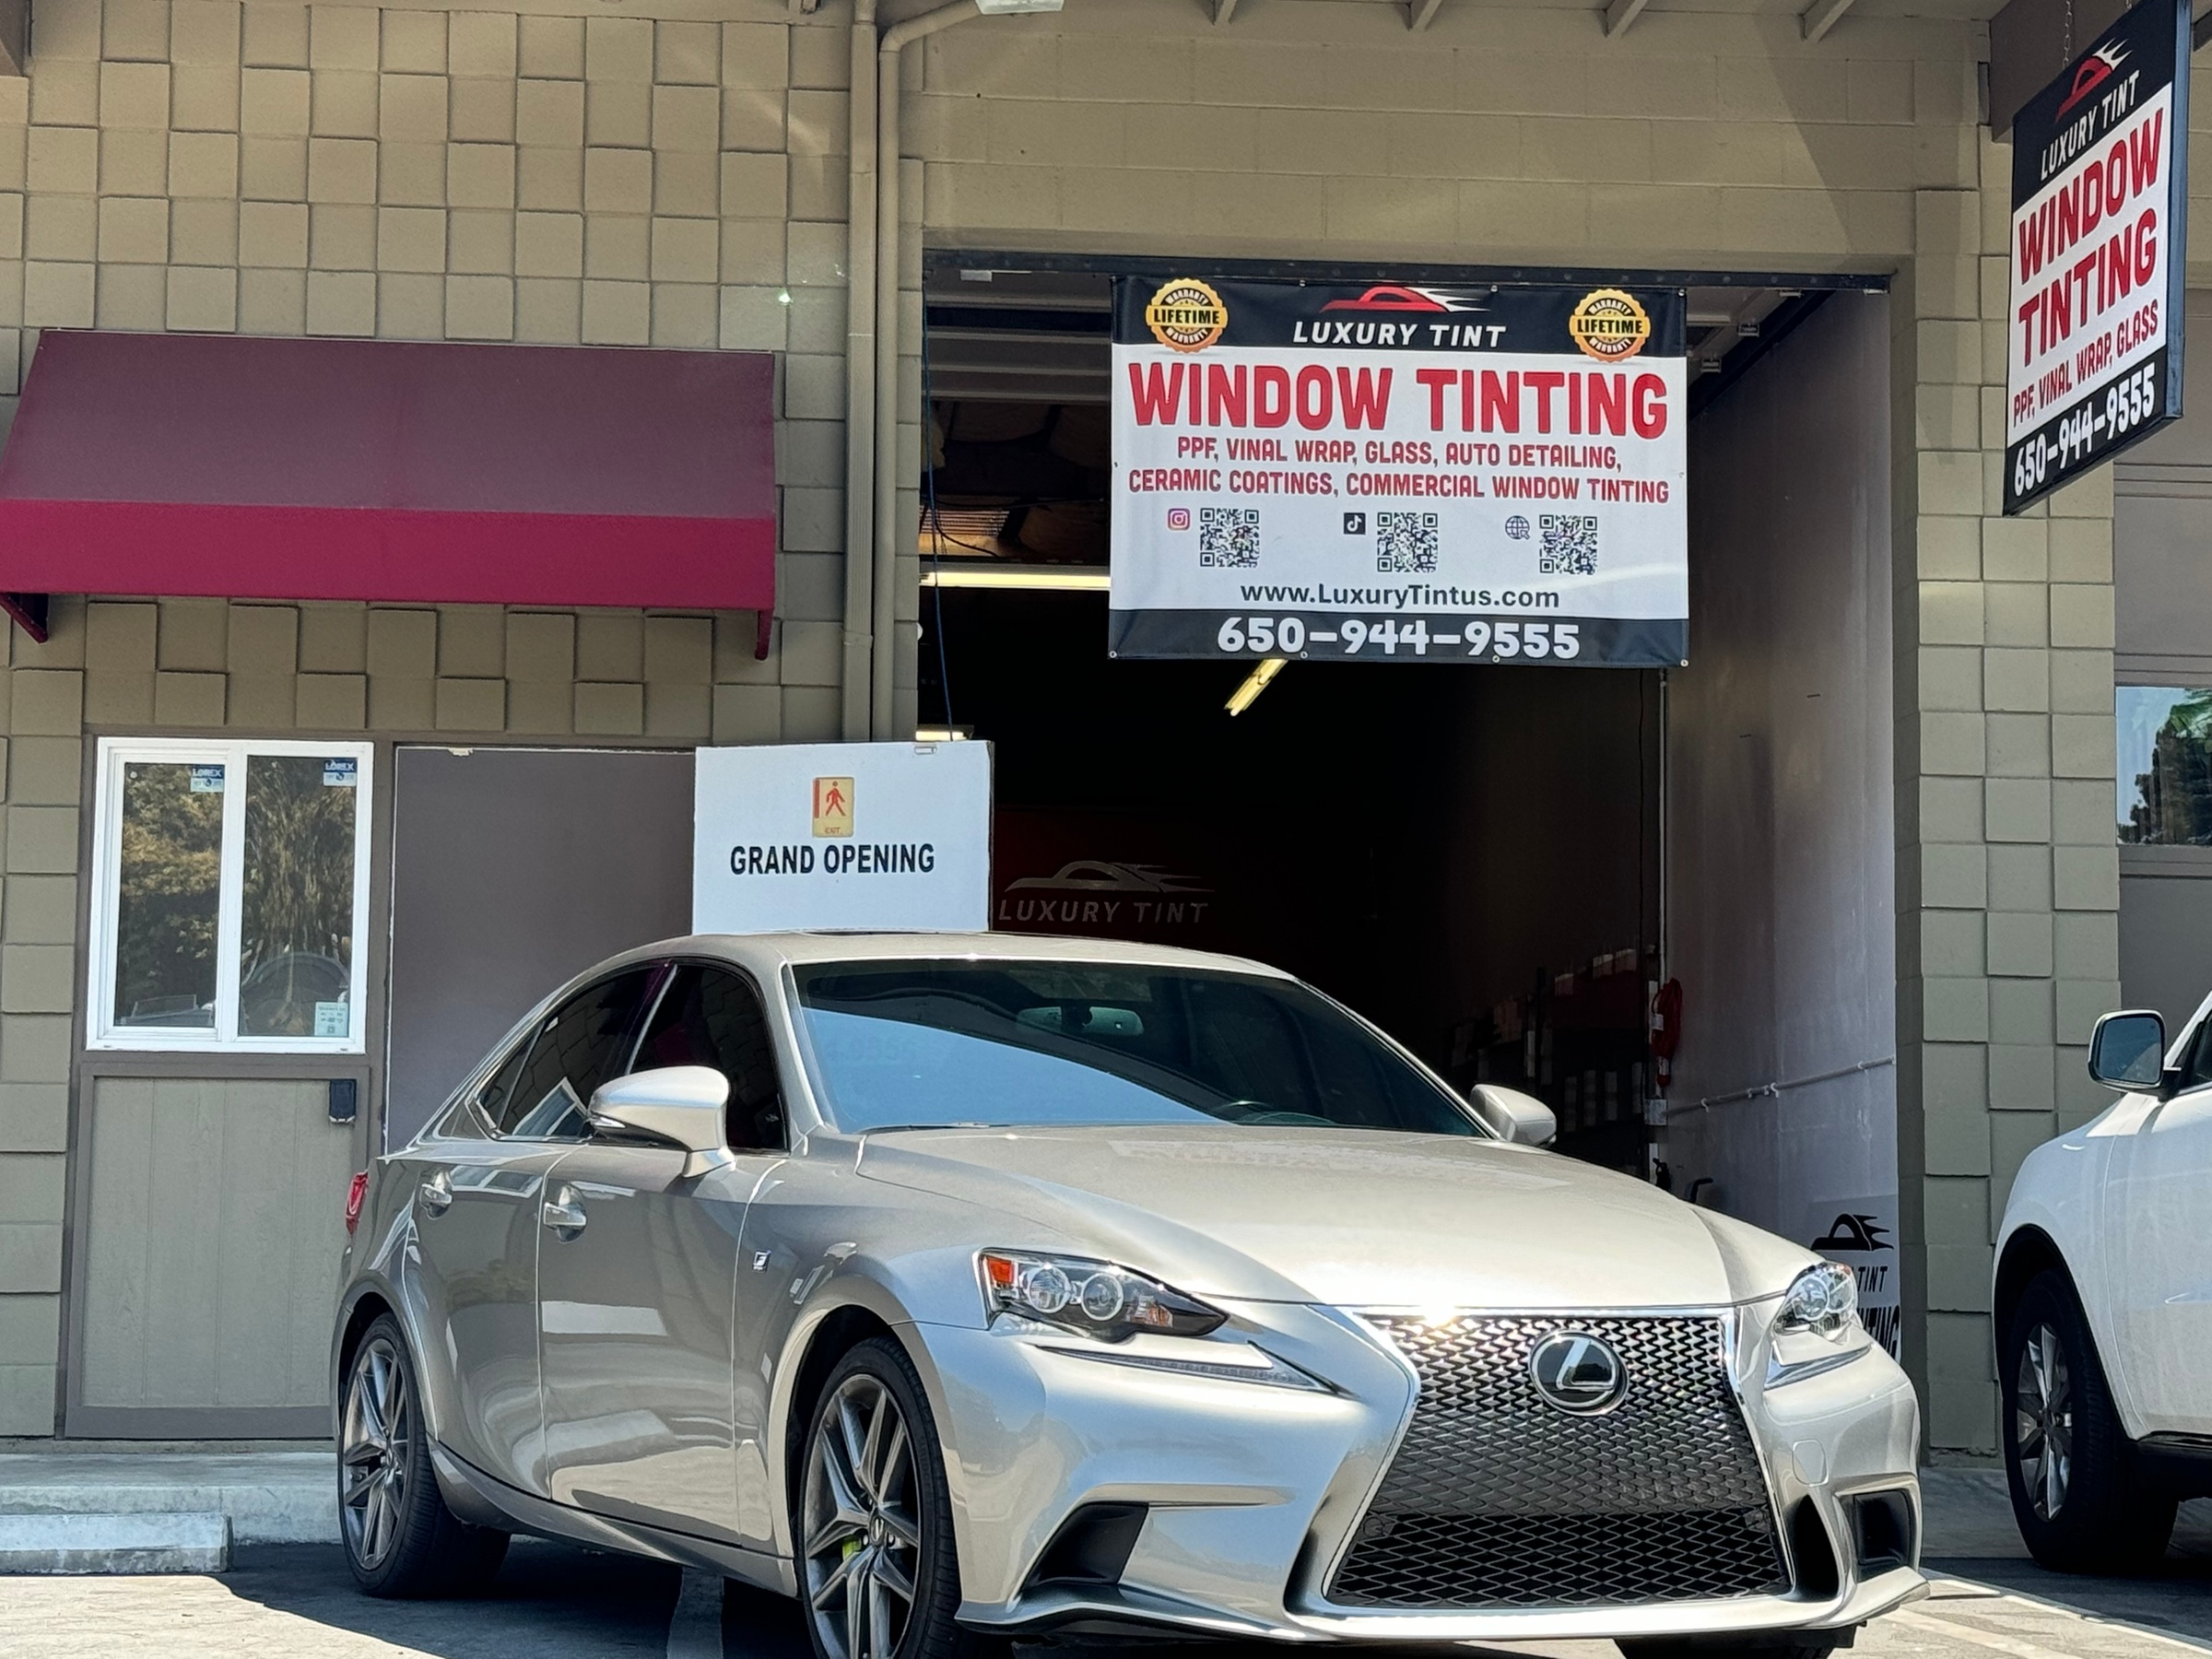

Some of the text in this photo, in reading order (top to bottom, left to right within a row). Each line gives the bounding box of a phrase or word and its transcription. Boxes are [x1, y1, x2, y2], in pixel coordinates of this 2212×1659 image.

[2041, 69, 2140, 182] LUXURY TINT
[2018, 107, 2164, 286] WINDOW
[2018, 207, 2158, 368] TINTING
[1154, 309, 1220, 324] LIFETIME
[1293, 322, 1507, 347] LUXURY TINT
[1577, 319, 1643, 335] LIFETIME
[2013, 298, 2159, 429] PPF, VINAL WRAP, GLASS
[1128, 362, 1668, 440] WINDOW TINTING
[2014, 361, 2156, 497] 650-944-9555
[1178, 436, 1622, 473] PPF, VINAL WRAP, GLASS, AUTO DETAILING,
[1129, 468, 1670, 504] CERAMIC COATINGS, COMMERCIAL WINDOW TINTING
[1241, 582, 1560, 609] www.LuxuryTintus.com
[1218, 617, 1581, 660] 650-944-9555
[730, 843, 936, 877] GRAND OPENING
[999, 899, 1209, 924] LUXURY TINT
[1855, 1265, 1889, 1294] TINT
